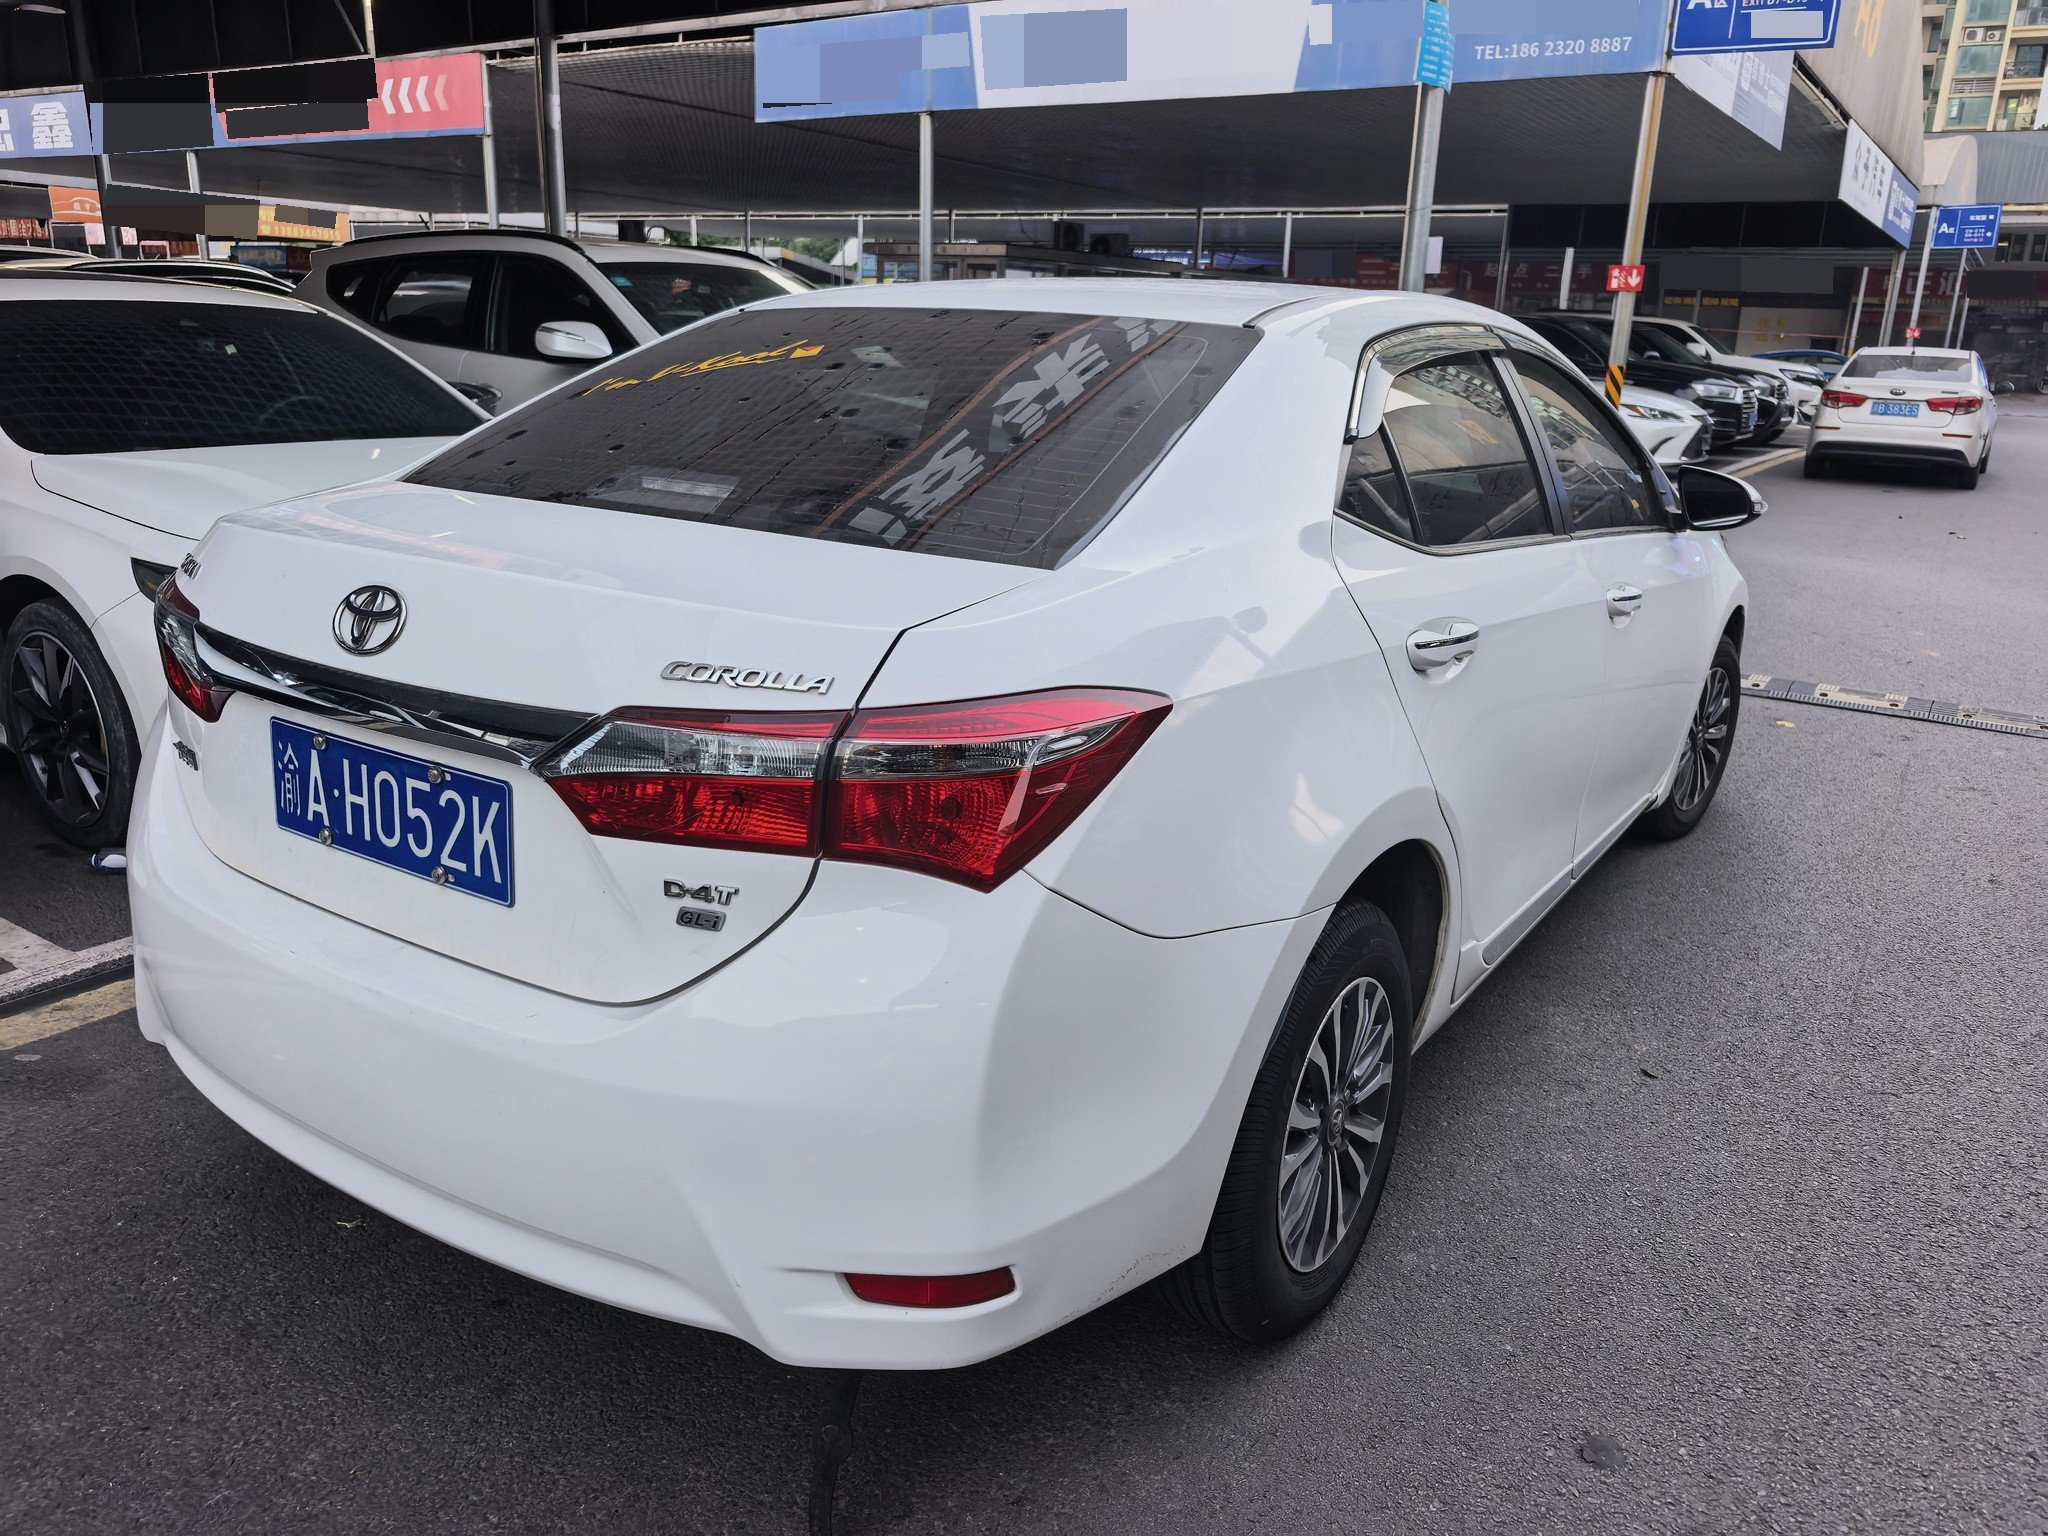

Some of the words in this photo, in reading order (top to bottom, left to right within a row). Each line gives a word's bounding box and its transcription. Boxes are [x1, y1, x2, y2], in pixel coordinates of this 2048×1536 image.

[1474, 42, 1540, 60] TEL:186
[1544, 39, 1585, 56] 2320
[1590, 36, 1633, 53] 8887
[660, 660, 836, 695] COROLLA
[663, 878, 740, 907] D-4T
[680, 911, 721, 930] GL-i
